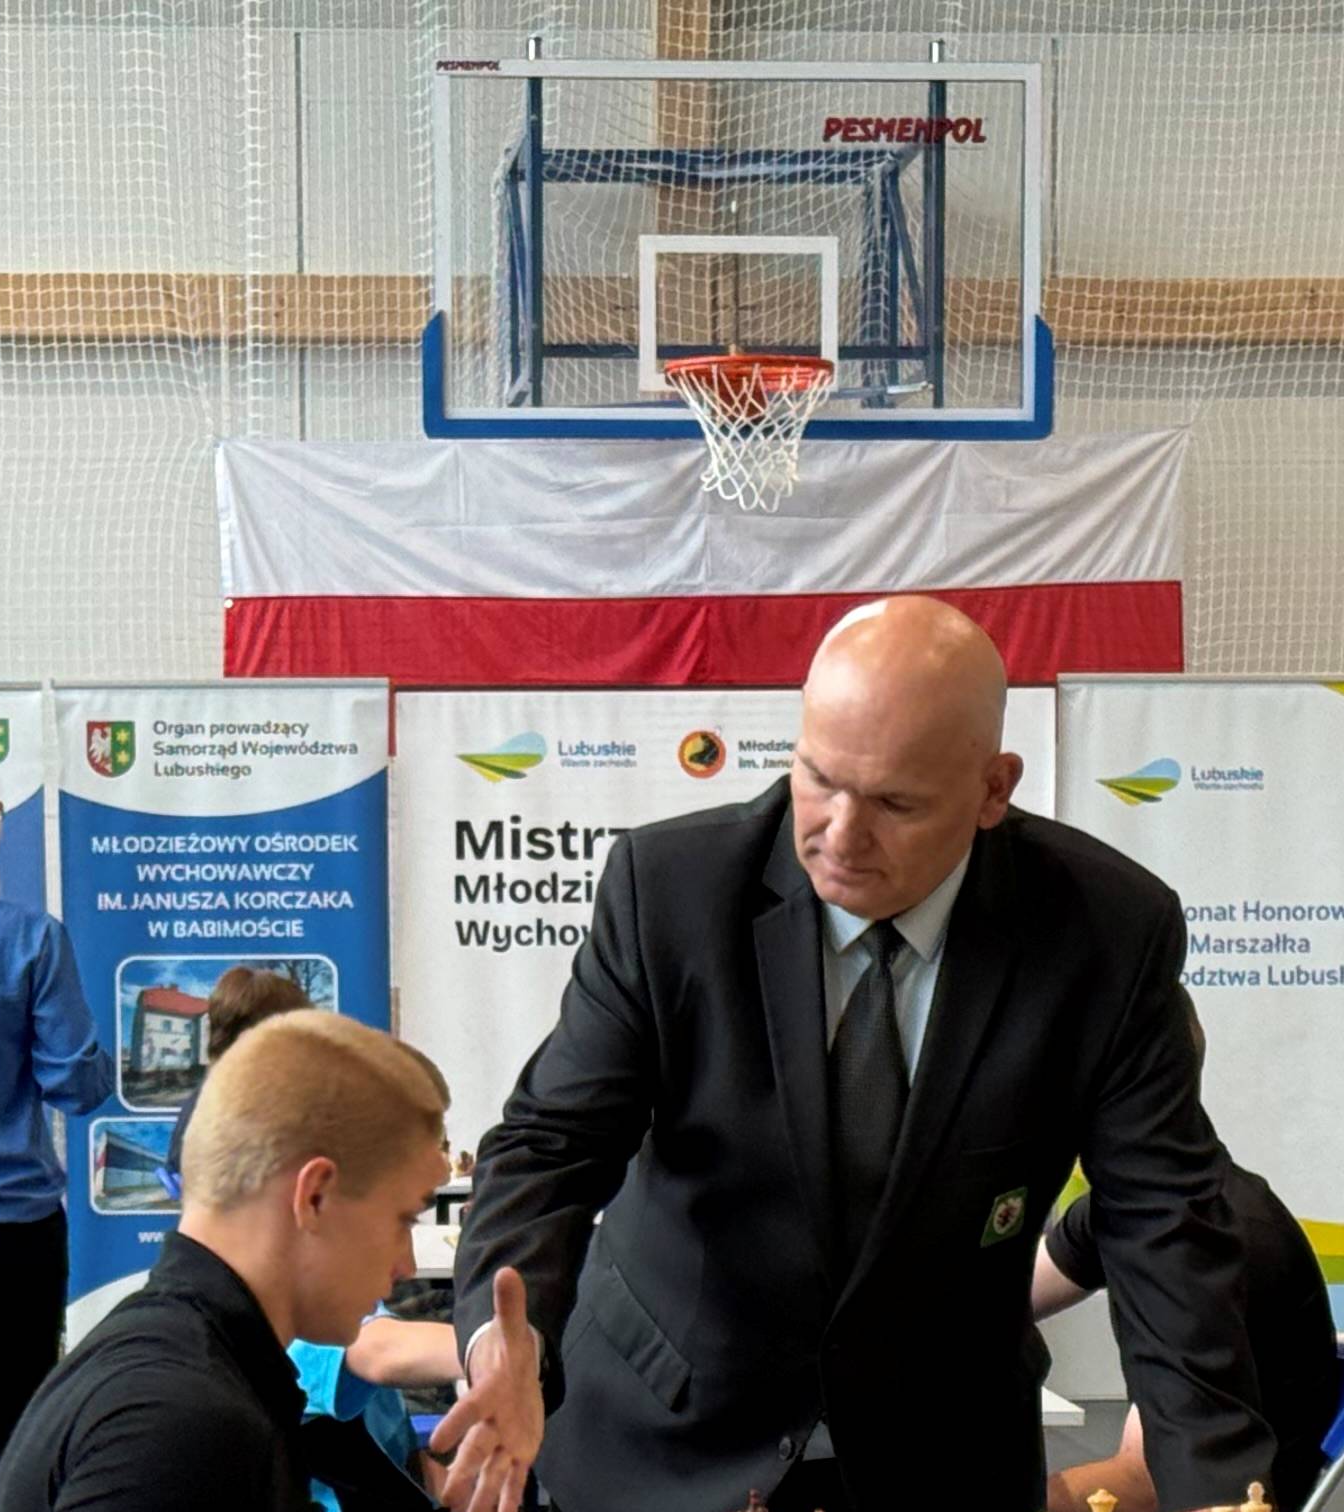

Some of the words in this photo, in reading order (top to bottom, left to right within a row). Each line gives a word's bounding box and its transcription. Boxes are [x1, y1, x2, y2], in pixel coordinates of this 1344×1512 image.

[823, 117, 987, 143] PESMENPOL
[153, 720, 204, 738] Organ
[209, 721, 309, 738] prowadzący
[153, 741, 238, 759] Samorząd
[242, 741, 359, 758] Województwa
[558, 740, 636, 756] Lubuskie
[155, 762, 252, 779] Lubuskiego
[1191, 766, 1264, 781] Lubuskie
[92, 832, 250, 854] MŁODZIEŻOWY
[255, 833, 359, 852] OŚRODEK
[137, 863, 314, 882] WYCHOWAWCZY
[97, 892, 127, 911] IM.
[131, 891, 230, 910] JANUSZA
[235, 890, 354, 909] KORCZAKA
[148, 920, 168, 938] W
[173, 916, 304, 937] BABIMOŚCIE
[1190, 933, 1311, 954] Marszałka
